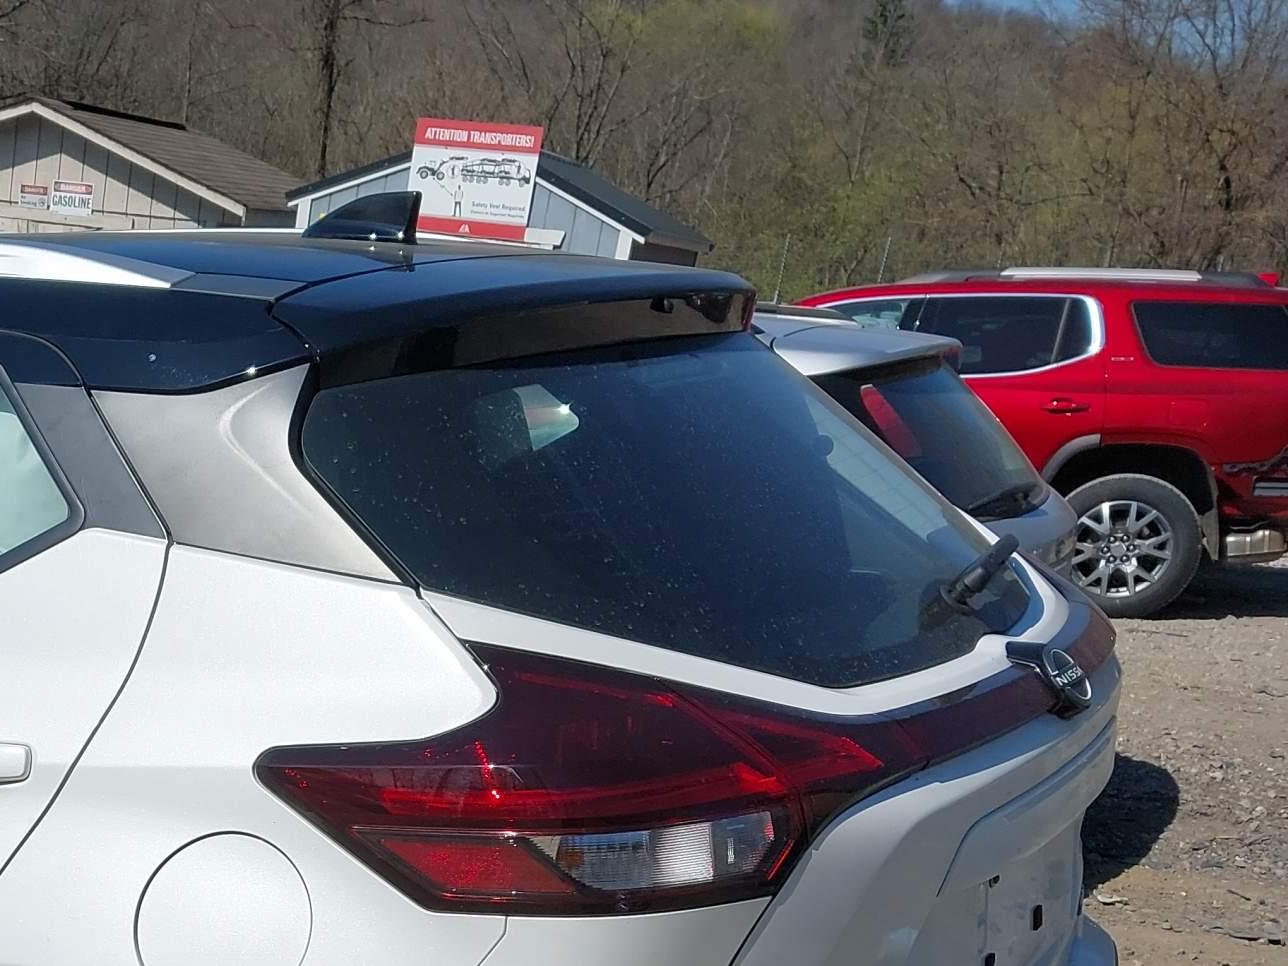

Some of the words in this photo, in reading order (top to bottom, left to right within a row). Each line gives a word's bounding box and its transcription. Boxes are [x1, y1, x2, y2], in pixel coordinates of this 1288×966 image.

[424, 127, 468, 143] ATTENTION
[470, 131, 535, 147] TRANSPORTERS!
[52, 193, 91, 209] GASOLINE
